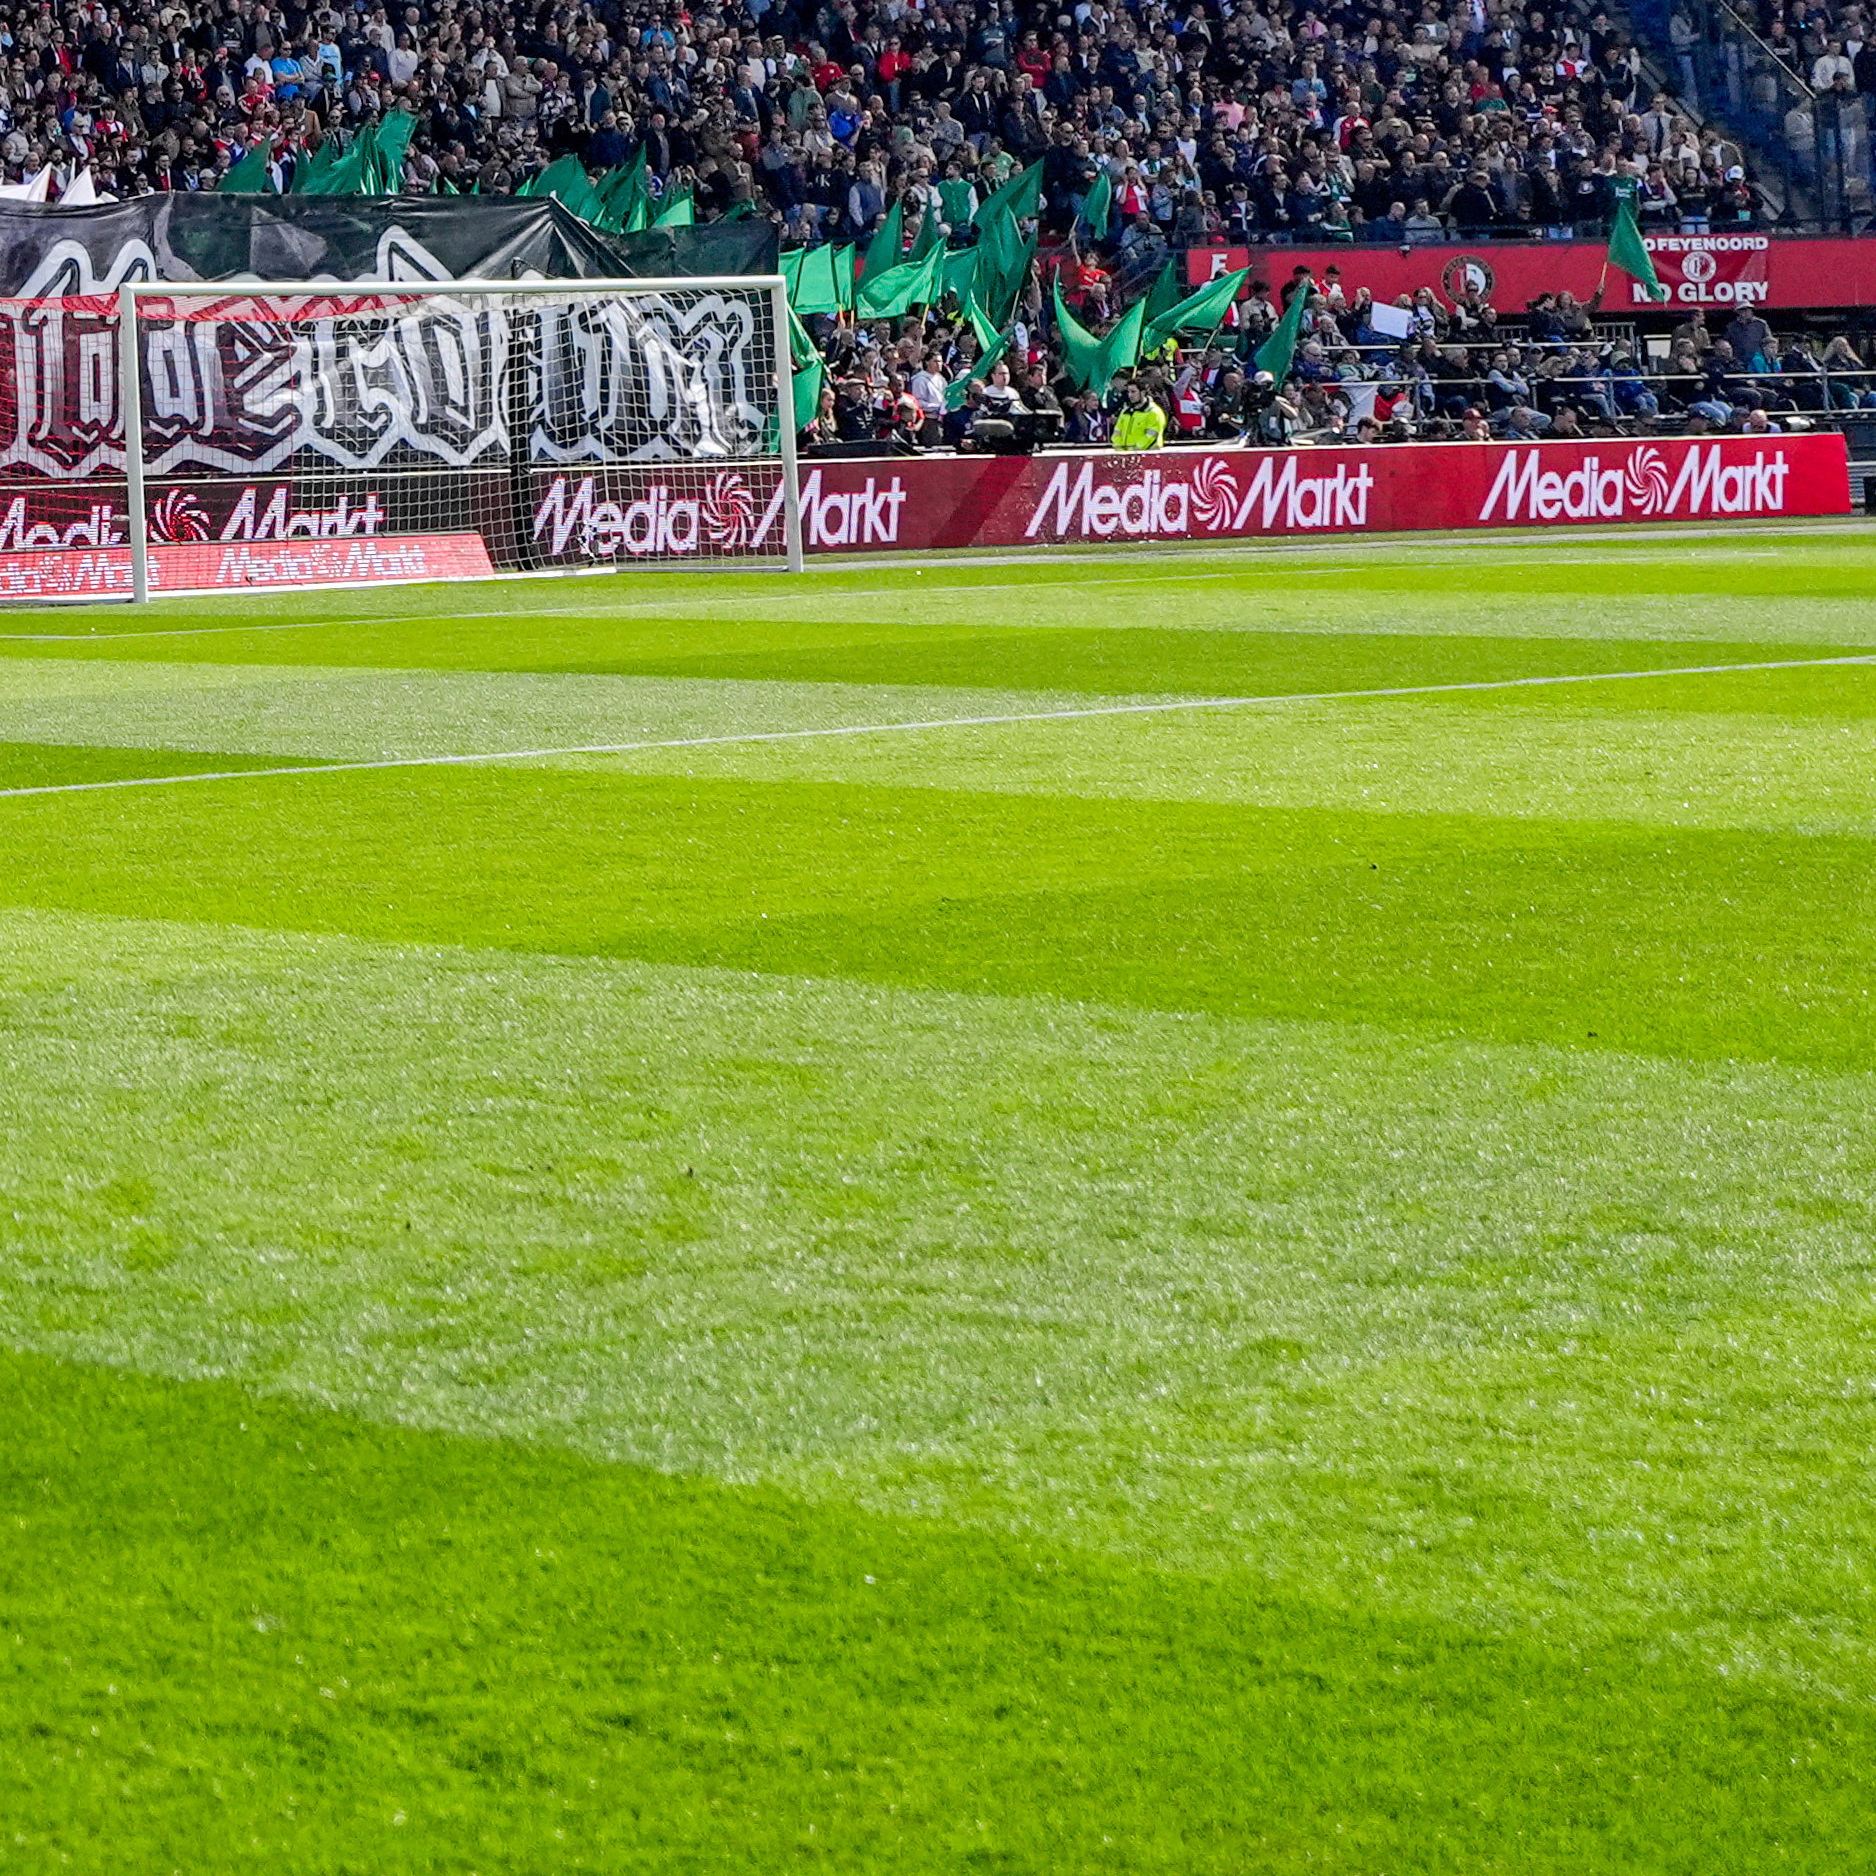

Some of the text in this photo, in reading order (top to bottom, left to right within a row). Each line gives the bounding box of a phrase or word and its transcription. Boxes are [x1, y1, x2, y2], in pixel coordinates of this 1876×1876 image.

[1657, 236, 1769, 252] FEYENOORD
[1677, 281, 1769, 303] GLORY
[533, 468, 907, 556] Media Markt
[1024, 454, 1374, 537] Media Markt
[1479, 444, 1789, 520] Media Markt
